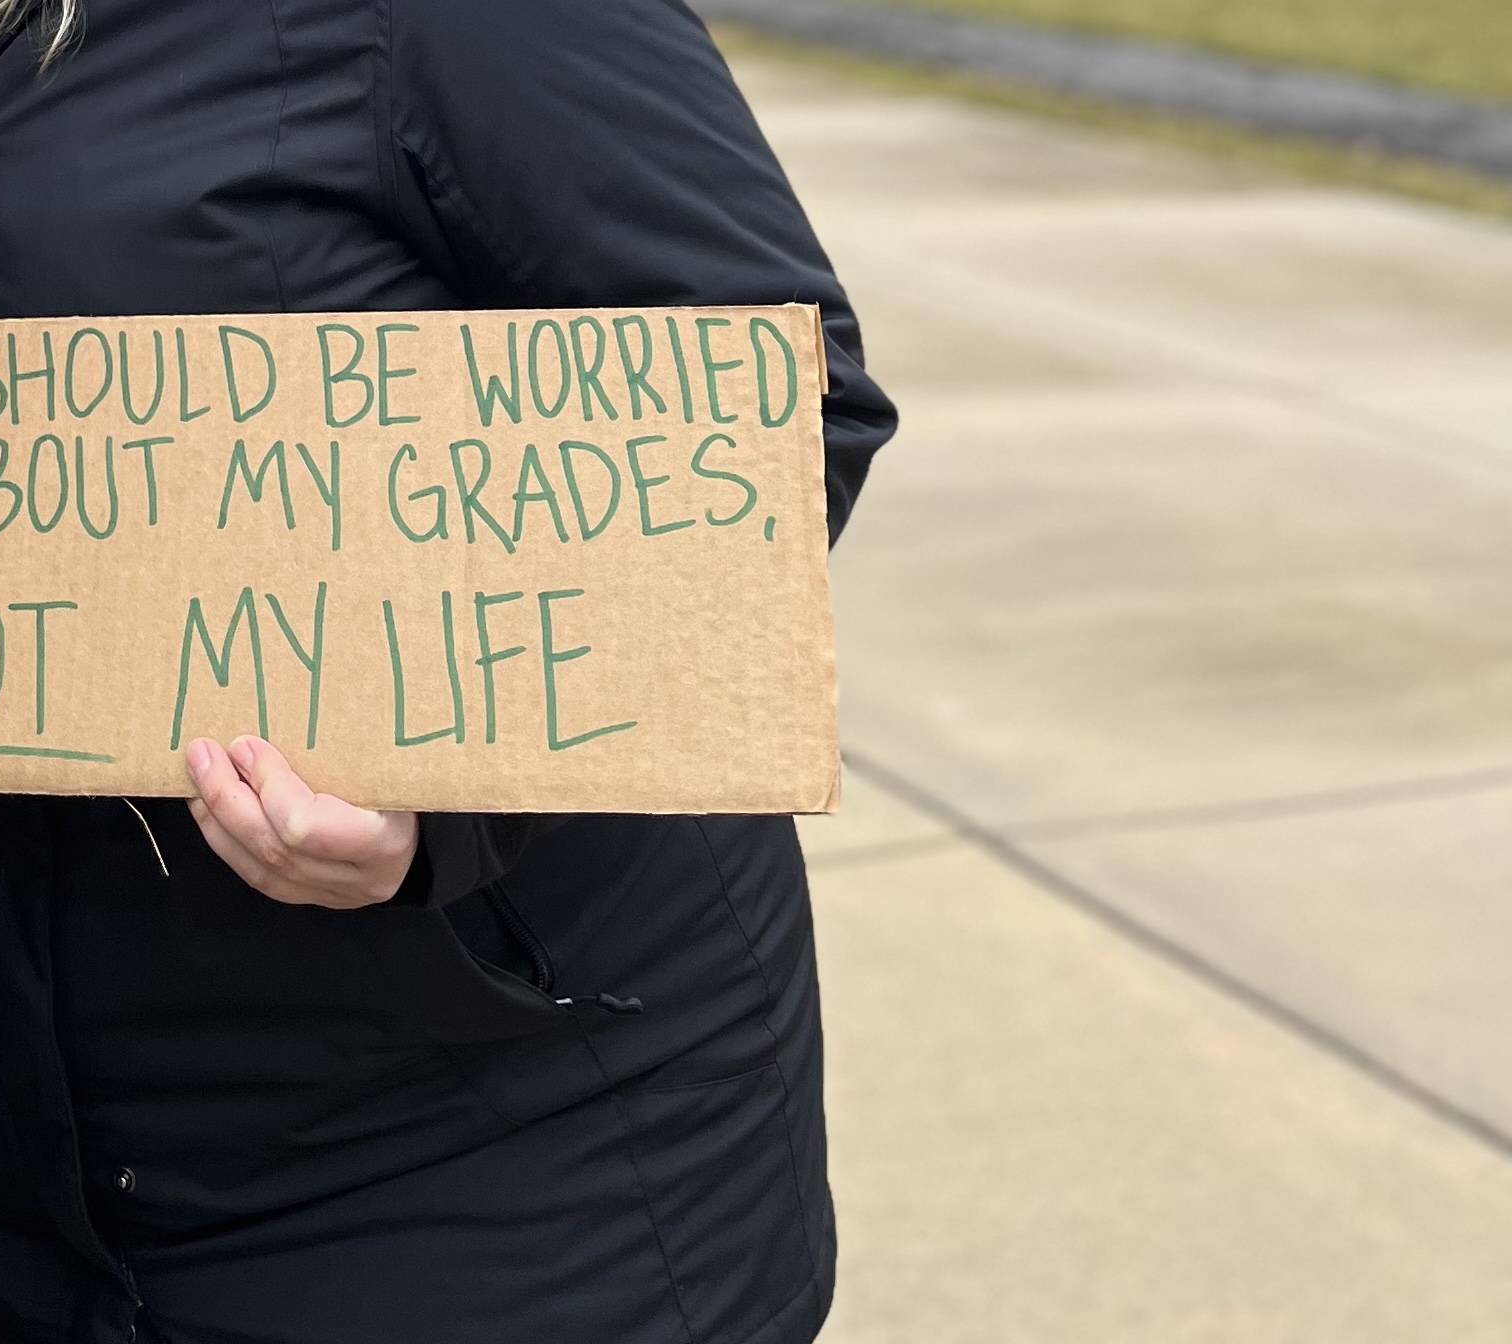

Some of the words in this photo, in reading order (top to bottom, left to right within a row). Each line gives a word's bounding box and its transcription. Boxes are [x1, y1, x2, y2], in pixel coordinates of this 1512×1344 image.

[316, 323, 421, 430] BE
[460, 315, 800, 430] WORRIED
[217, 439, 343, 553] MY
[387, 431, 778, 556] GRADES,
[169, 581, 329, 753] MY
[381, 588, 639, 753] LIFE
